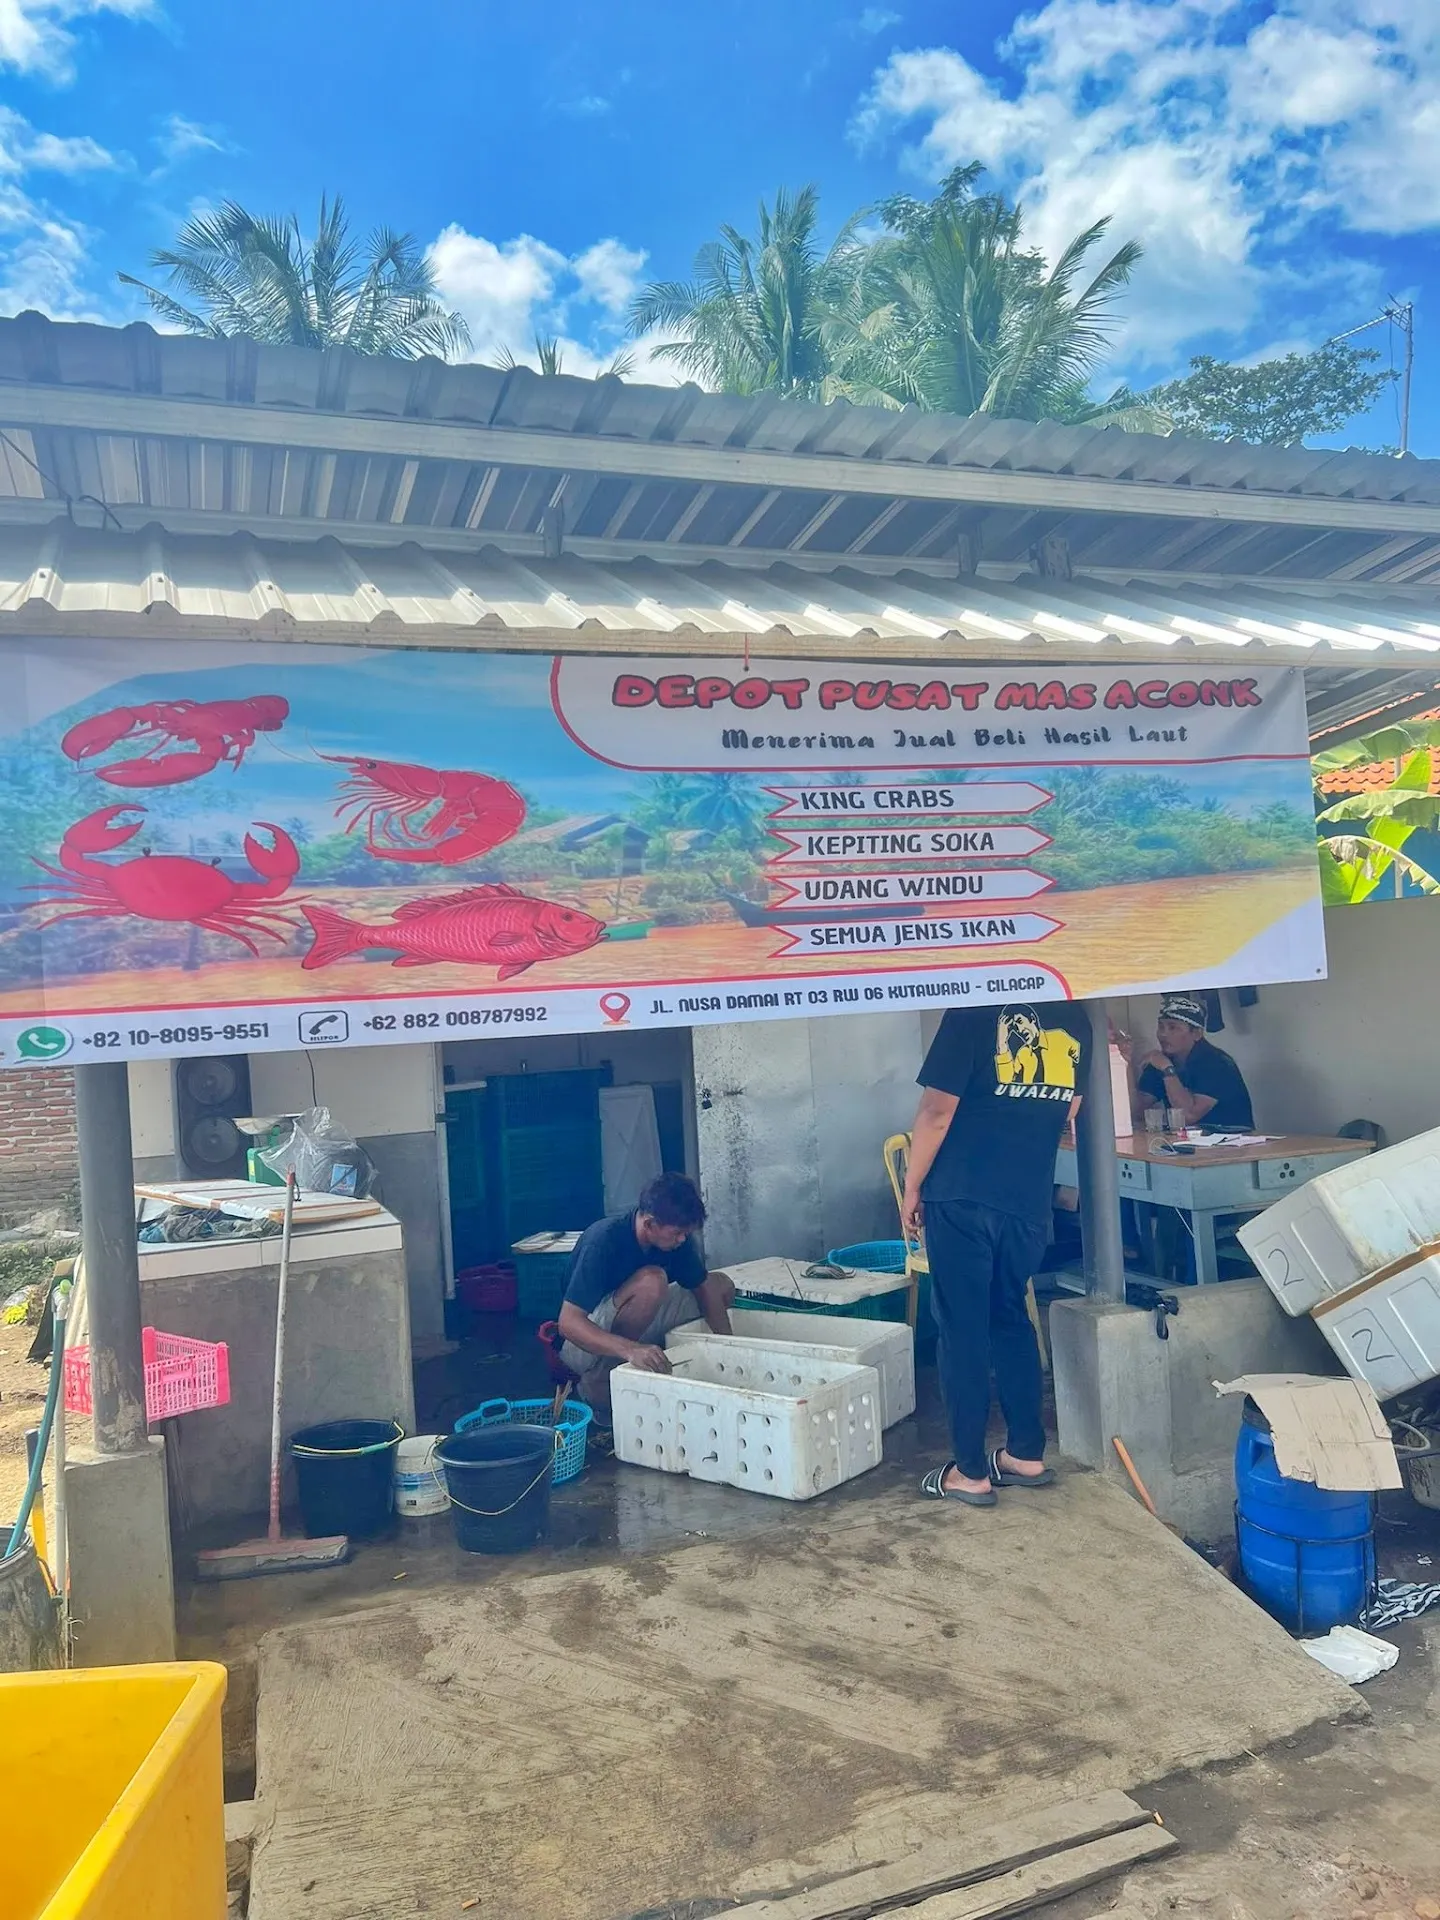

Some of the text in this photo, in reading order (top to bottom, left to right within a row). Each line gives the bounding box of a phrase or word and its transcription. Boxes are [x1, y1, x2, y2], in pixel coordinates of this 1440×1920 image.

[612, 674, 1263, 711] DEPOT PUSAT MAS ACONK
[722, 725, 1188, 749] Menerima Jual Beli Hasil Laut
[801, 789, 954, 810] KING CRABS
[807, 832, 994, 855] KEPITING SOKA
[804, 875, 983, 900] UDANG WINDU
[810, 919, 1016, 946] SEMUA JENIS IKAN
[650, 1000, 673, 1014] JL.
[679, 995, 721, 1012] NUSA
[726, 992, 779, 1010] DAMAI
[784, 991, 803, 1006] RT
[808, 989, 828, 1004] 03
[833, 987, 859, 1002] RW
[864, 987, 884, 1000] 06
[888, 981, 970, 999] KUTAWARU
[987, 976, 1045, 993] CILACAP
[363, 1006, 547, 1030] +62 882 008787992
[82, 1022, 269, 1048] +82 10-8095-9551
[1268, 1248, 1304, 1286] 2
[1351, 1328, 1395, 1362] 2
